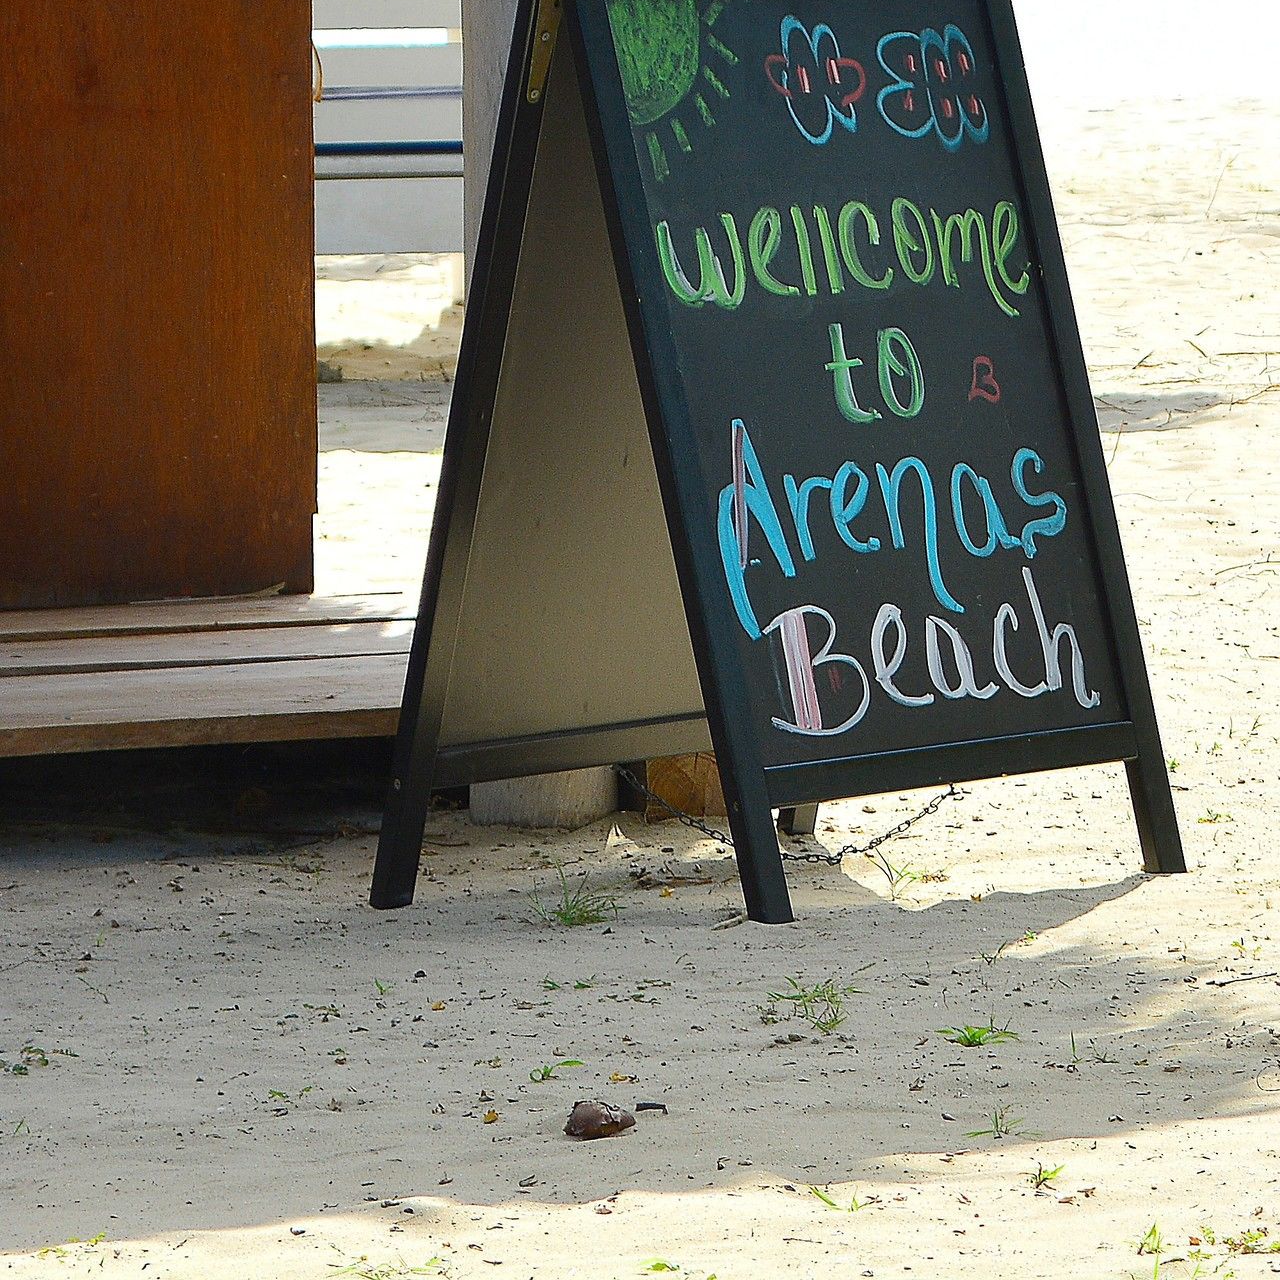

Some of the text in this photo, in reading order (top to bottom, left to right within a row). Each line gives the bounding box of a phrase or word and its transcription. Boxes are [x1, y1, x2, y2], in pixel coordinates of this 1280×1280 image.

[824, 323, 926, 423] to
[718, 418, 1067, 640] Arenas
[762, 567, 1100, 736] Beach
